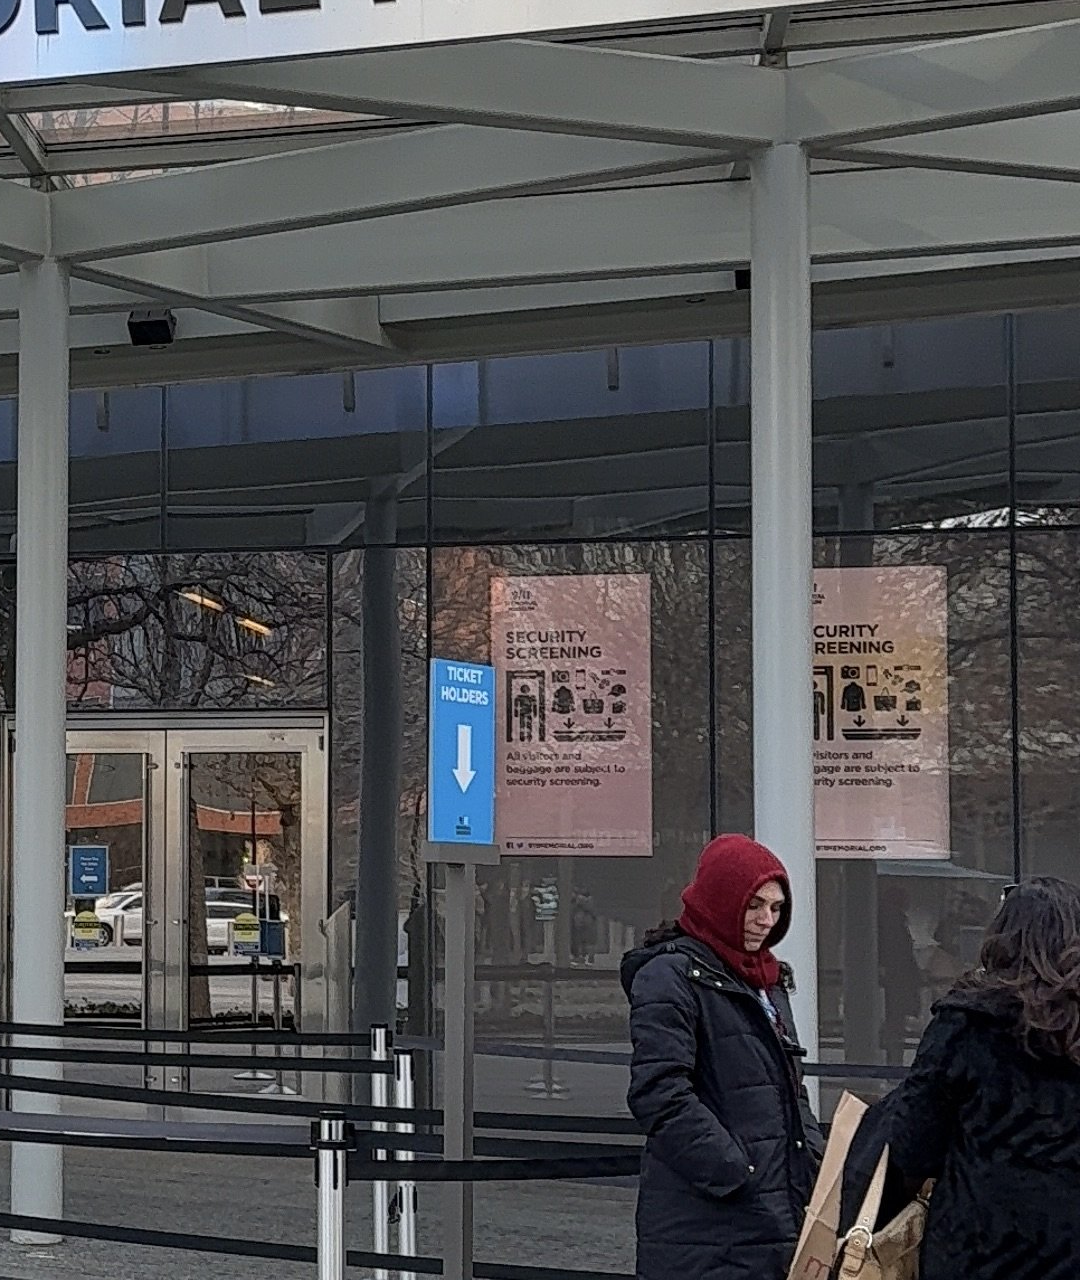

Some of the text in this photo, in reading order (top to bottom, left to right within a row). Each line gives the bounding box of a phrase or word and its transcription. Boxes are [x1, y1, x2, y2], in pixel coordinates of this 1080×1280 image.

[813, 623, 879, 638] CURITY
[506, 630, 587, 644] SECURITY
[506, 646, 602, 660] SCREENING
[814, 640, 895, 655] REENING
[446, 665, 484, 685] TICKET
[440, 685, 490, 706] HOLDERS
[522, 752, 559, 761] visitors
[562, 752, 582, 761] and
[851, 751, 873, 760] and
[506, 764, 552, 774] baggage
[574, 764, 611, 774] subject
[614, 764, 626, 773] to
[814, 764, 920, 775] gage are subject to
[506, 777, 602, 788] security screening.
[838, 777, 896, 788] screening.
